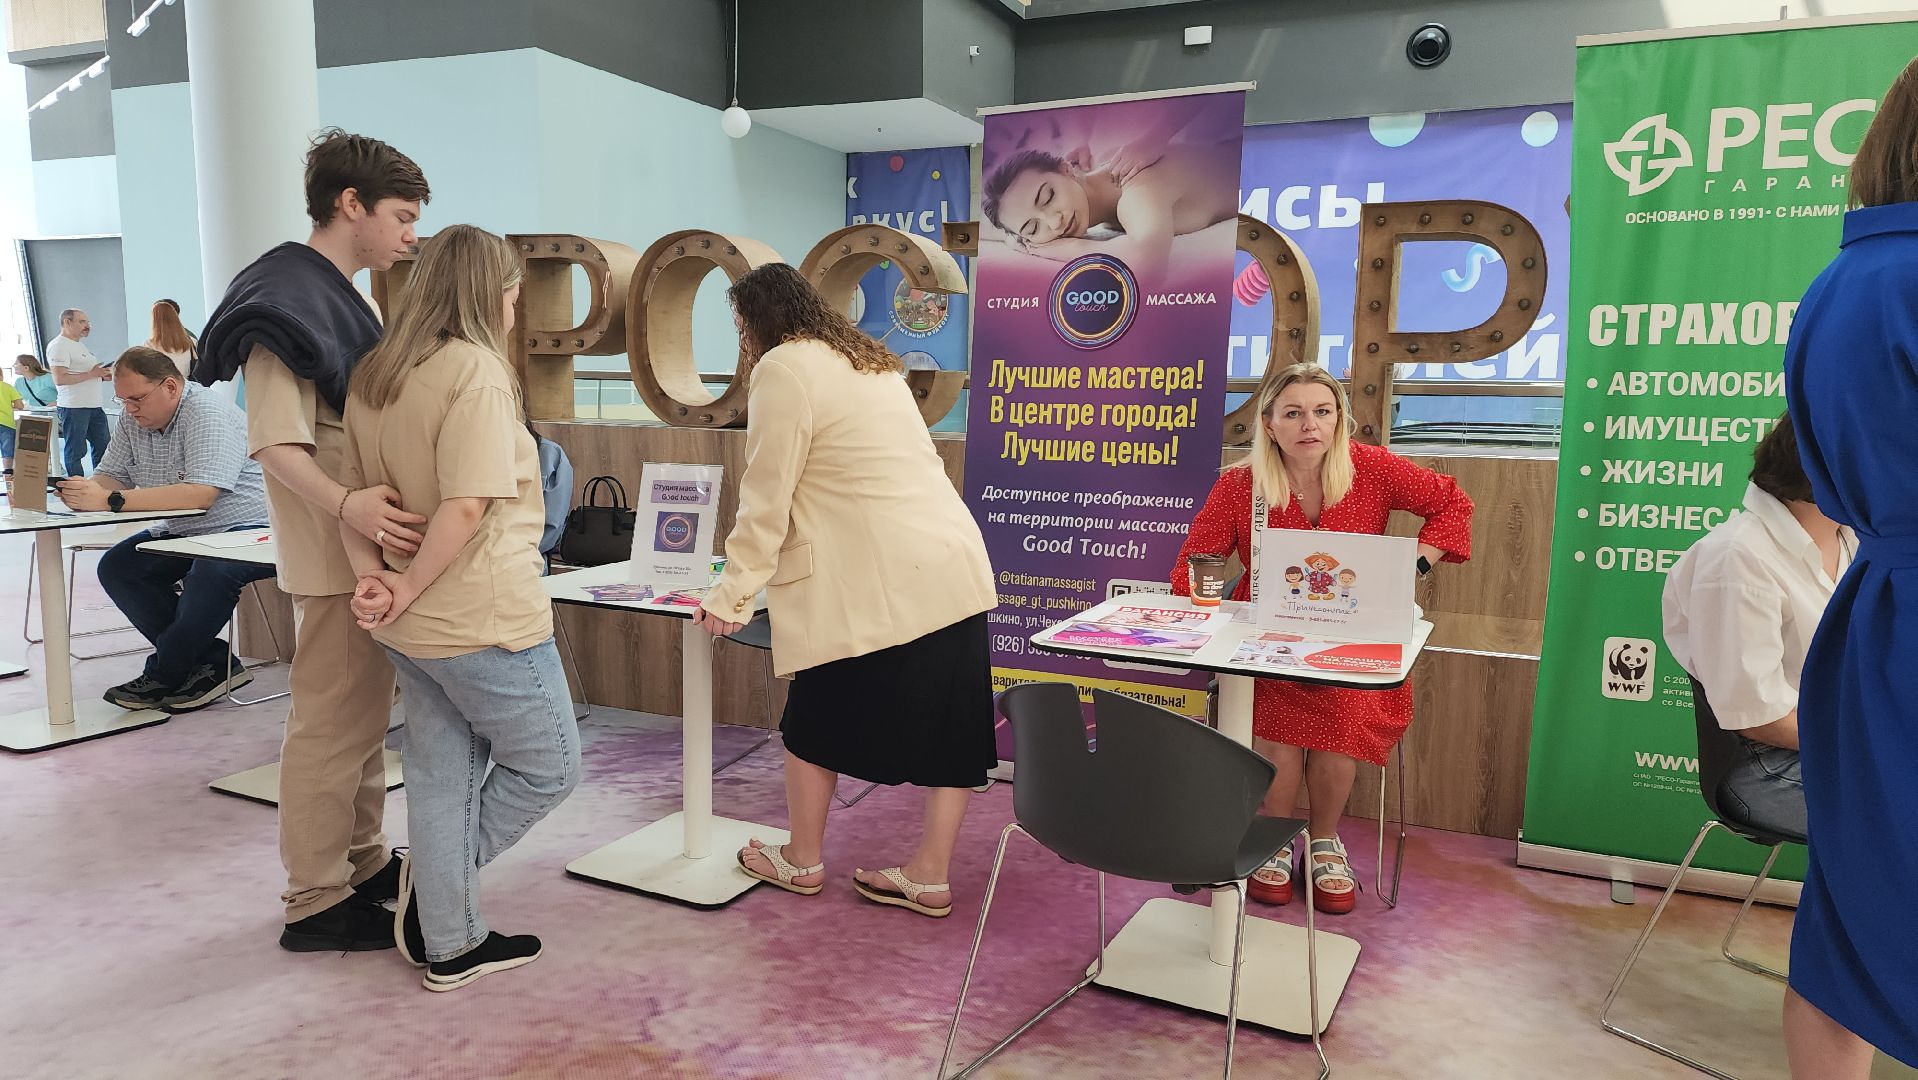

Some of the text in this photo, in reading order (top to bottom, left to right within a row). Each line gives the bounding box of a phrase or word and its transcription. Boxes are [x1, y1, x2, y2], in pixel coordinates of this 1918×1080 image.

[1625, 209, 1710, 224] ОСНОВАНО
[1714, 208, 1724, 221] В
[1776, 206, 1787, 218] С
[1790, 204, 1840, 218] НАМИ
[987, 292, 1217, 310] СТУДИЯ МАССАЖА
[1066, 290, 1119, 305] GOOD
[1075, 302, 1108, 312] touch
[988, 359, 1205, 395] Лучшие мастера!
[990, 395, 1197, 432] В центре города!
[1604, 415, 1781, 446] ИМУЩЕСТ
[1001, 431, 1179, 467] Лучшие цены!
[1601, 459, 1724, 487] ЖИЗНИ
[653, 483, 710, 493] Студия масса
[661, 493, 679, 501] Good
[982, 485, 1194, 510] Доступное преображение
[988, 512, 1189, 535] на территории массажа
[1254, 495, 1265, 532] GUESS
[1023, 534, 1147, 560] Good Touch!
[1000, 570, 1097, 593] @tatianamassagist
[1120, 607, 1207, 620] ВАКАНСИЯ
[1608, 681, 1646, 694] WWF
[1663, 675, 1671, 683] С
[1675, 699, 1695, 708] Все
